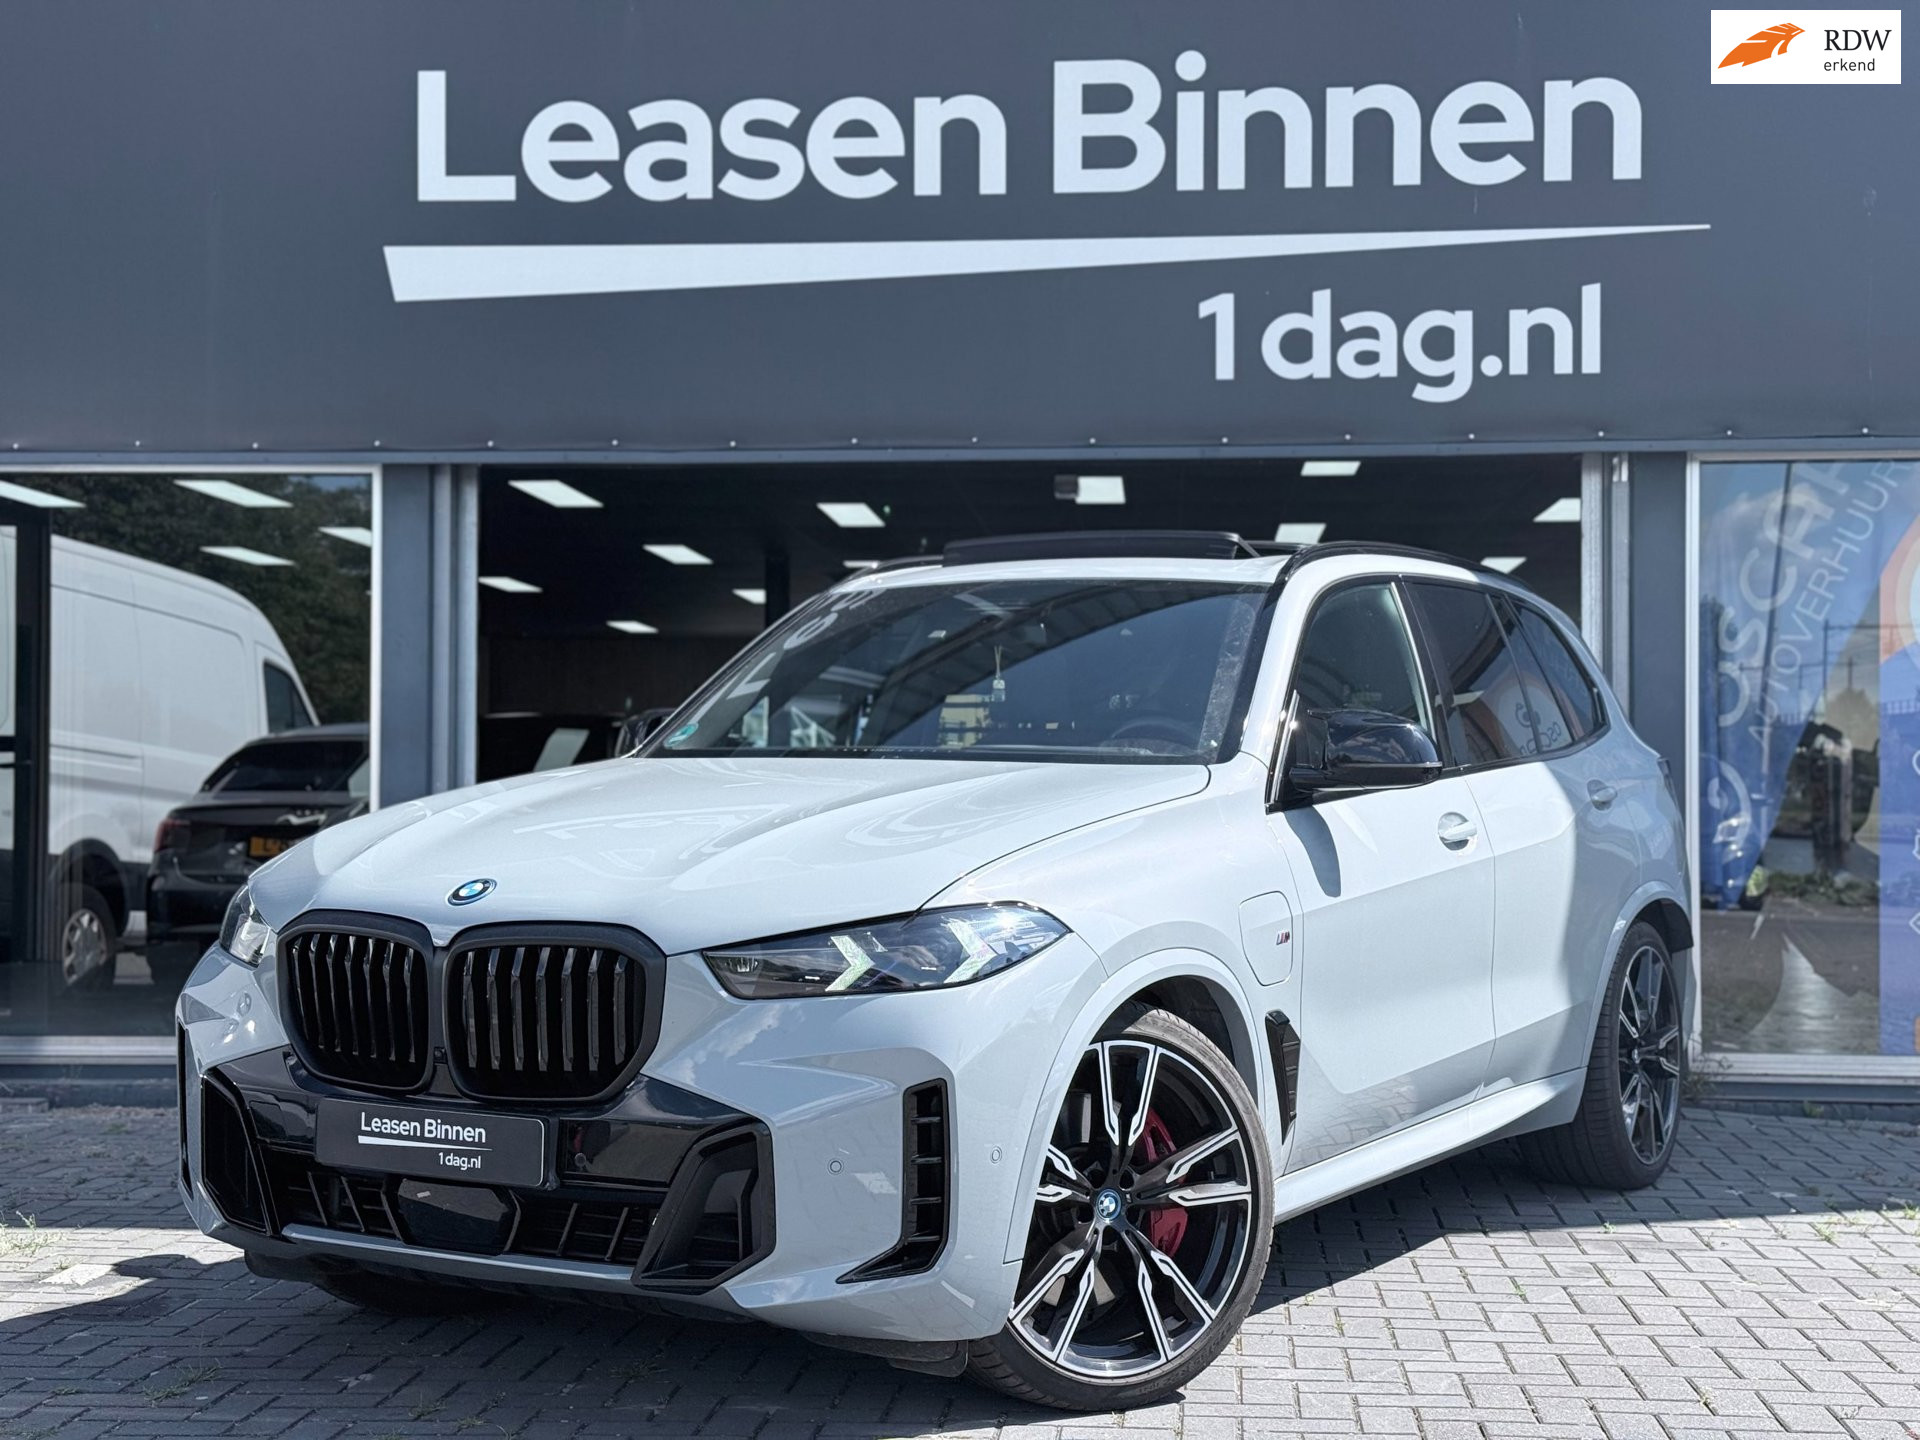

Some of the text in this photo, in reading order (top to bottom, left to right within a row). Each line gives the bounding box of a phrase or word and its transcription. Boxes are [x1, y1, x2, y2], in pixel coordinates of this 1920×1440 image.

[417, 50, 1642, 203] Leasen Binnen
[361, 1111, 486, 1143] Leasen Binnen
